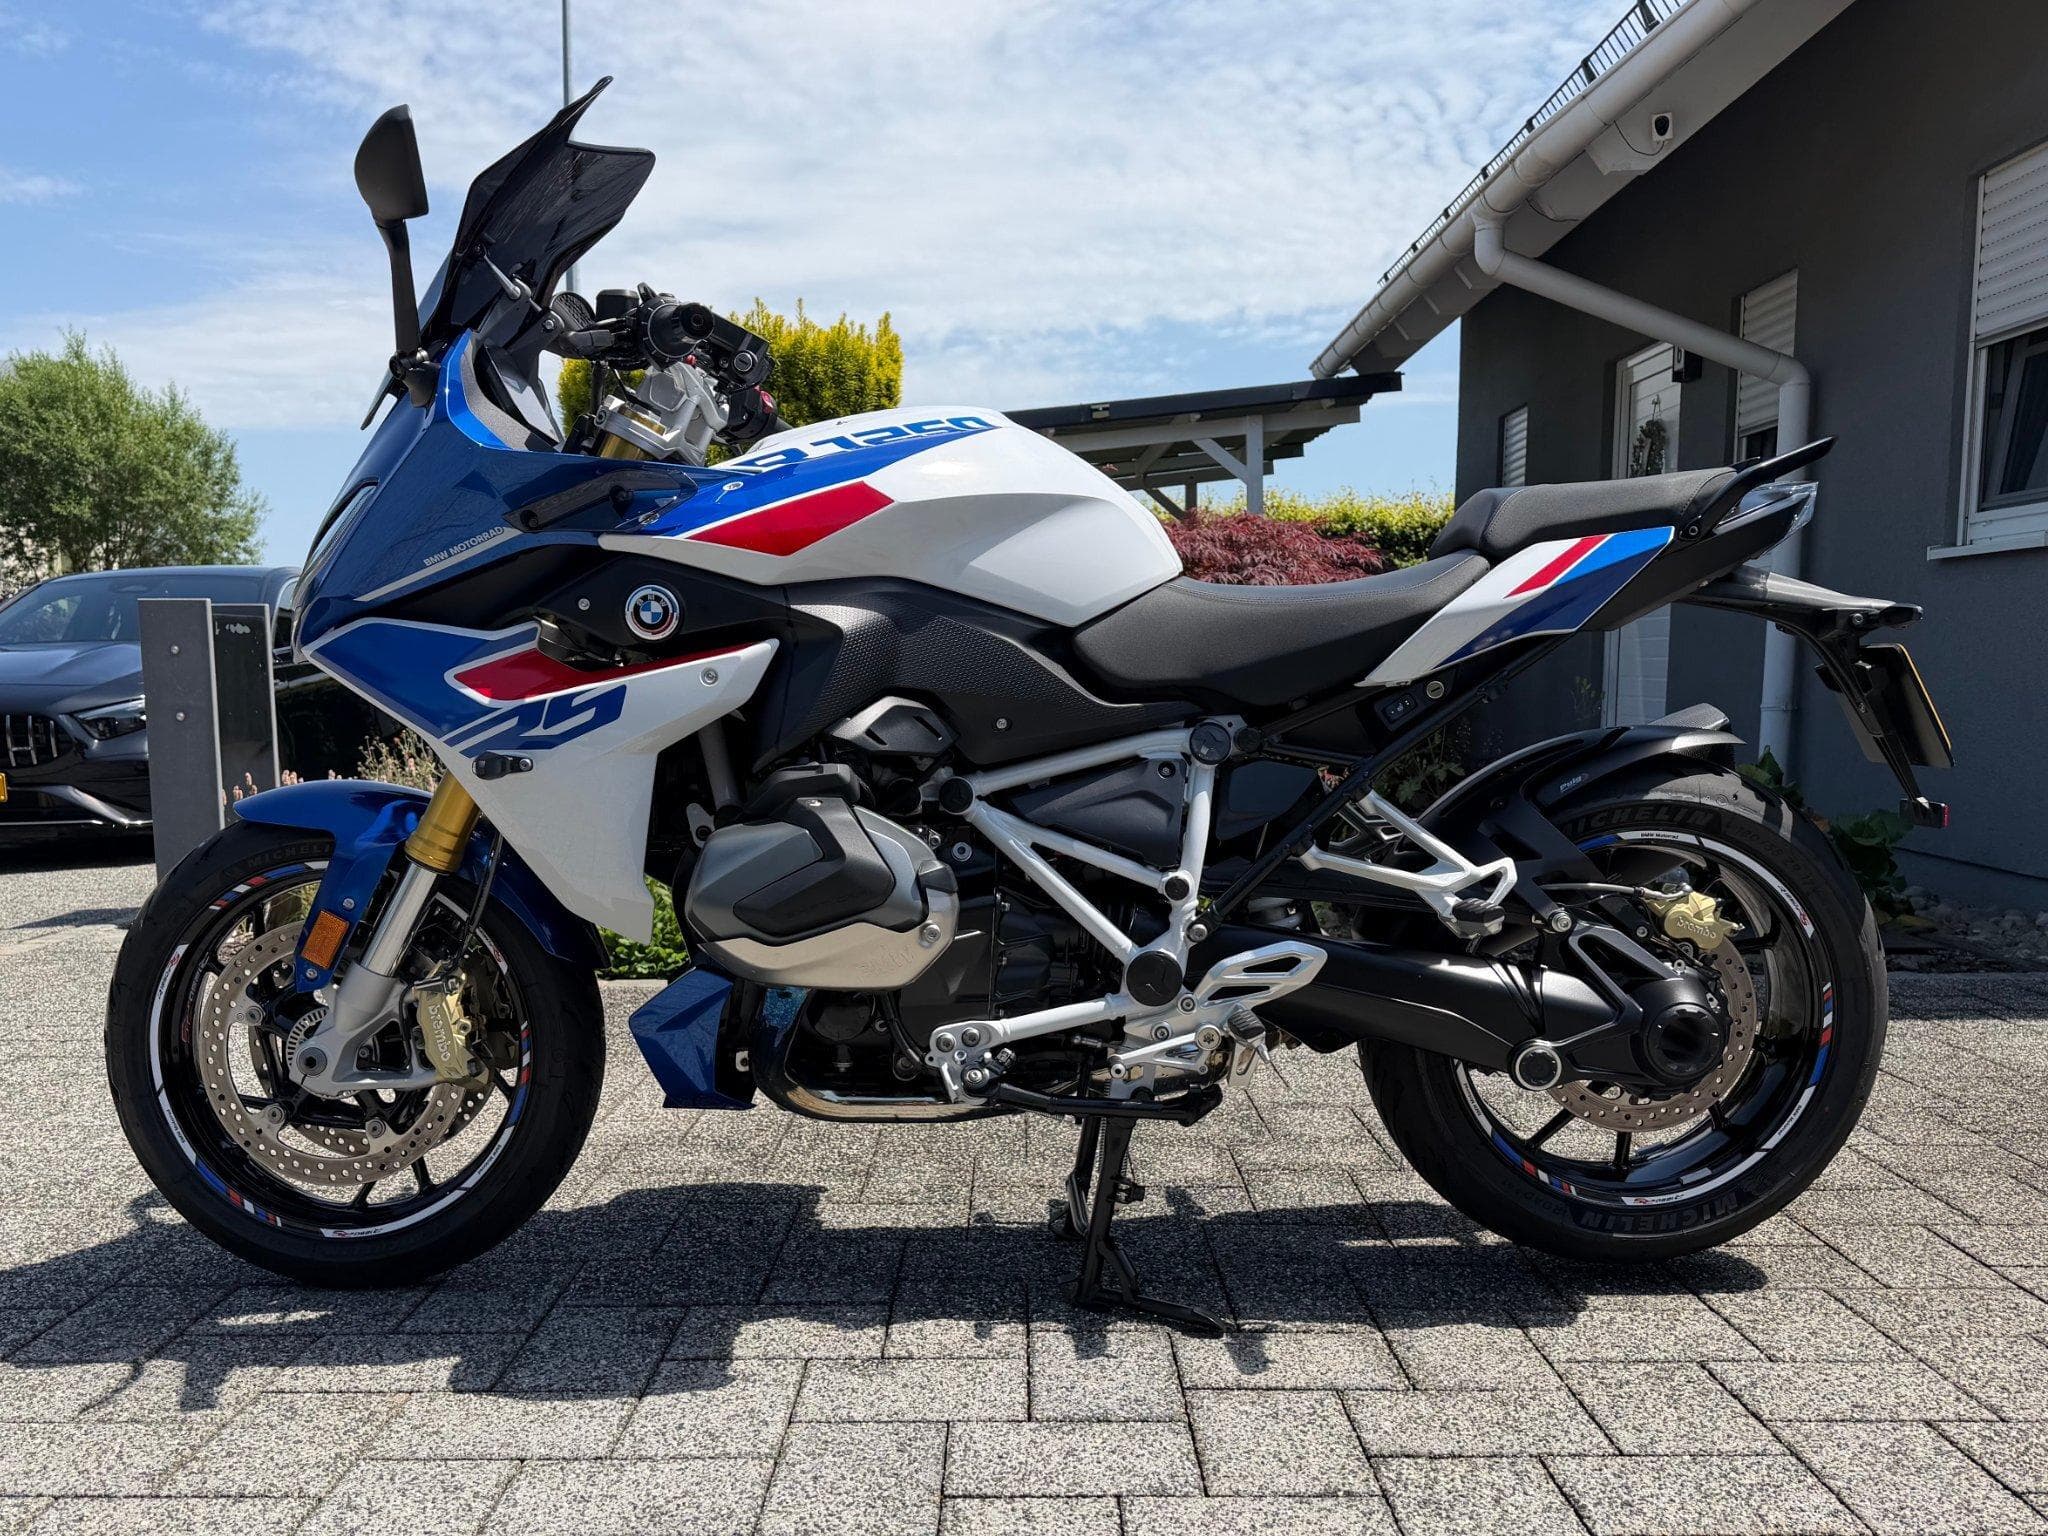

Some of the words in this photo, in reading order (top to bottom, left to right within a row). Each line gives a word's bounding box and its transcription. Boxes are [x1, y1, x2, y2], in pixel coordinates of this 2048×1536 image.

[423, 549, 448, 566] BMW
[449, 526, 504, 556] MOTORRAD
[247, 843, 331, 869] MICHELI
[1676, 916, 1716, 939] brembo
[428, 1004, 451, 1061] brembo
[1579, 1190, 1740, 1231] MICHELIN
